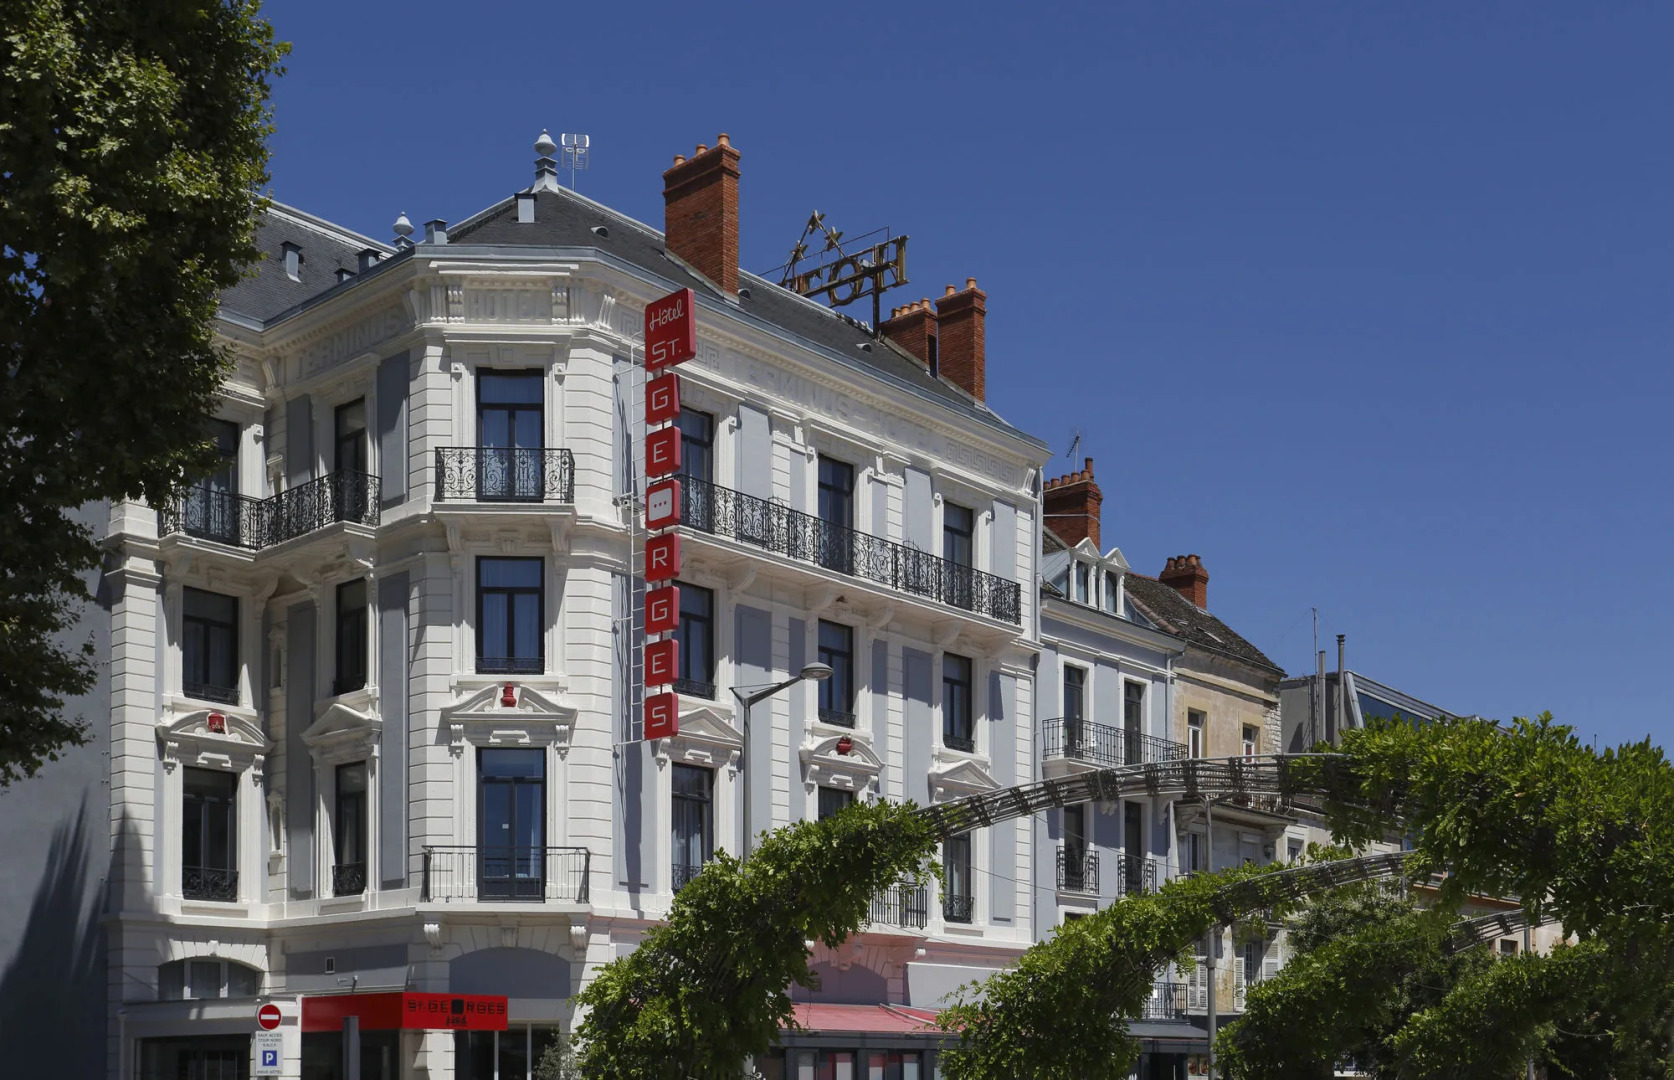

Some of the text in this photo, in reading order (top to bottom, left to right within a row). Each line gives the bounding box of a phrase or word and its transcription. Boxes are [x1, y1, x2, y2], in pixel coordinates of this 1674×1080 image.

[650, 299, 684, 331] Hôtel
[296, 311, 399, 379] TERMINUS
[266, 1053, 273, 1064] P
